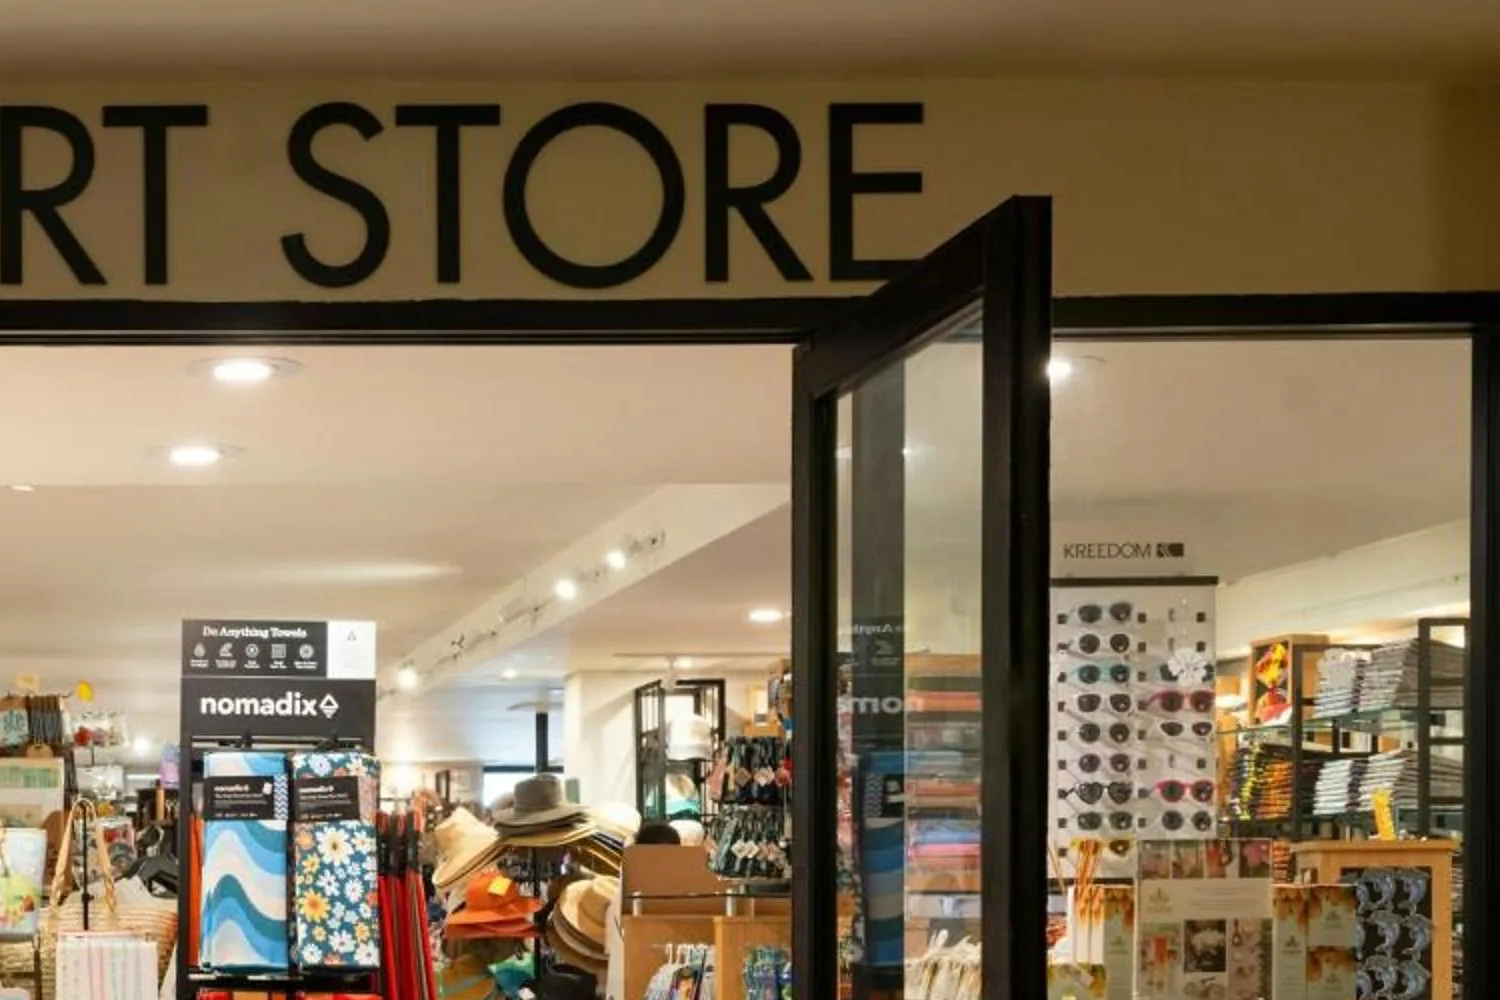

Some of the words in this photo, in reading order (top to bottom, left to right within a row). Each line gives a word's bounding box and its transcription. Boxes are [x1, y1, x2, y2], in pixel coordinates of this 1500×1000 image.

[282, 102, 924, 289] STORE
[1063, 543, 1151, 558] KREEDOM
[220, 627, 269, 639] Anything
[270, 627, 307, 638] Towels
[201, 692, 317, 716] nomadix
